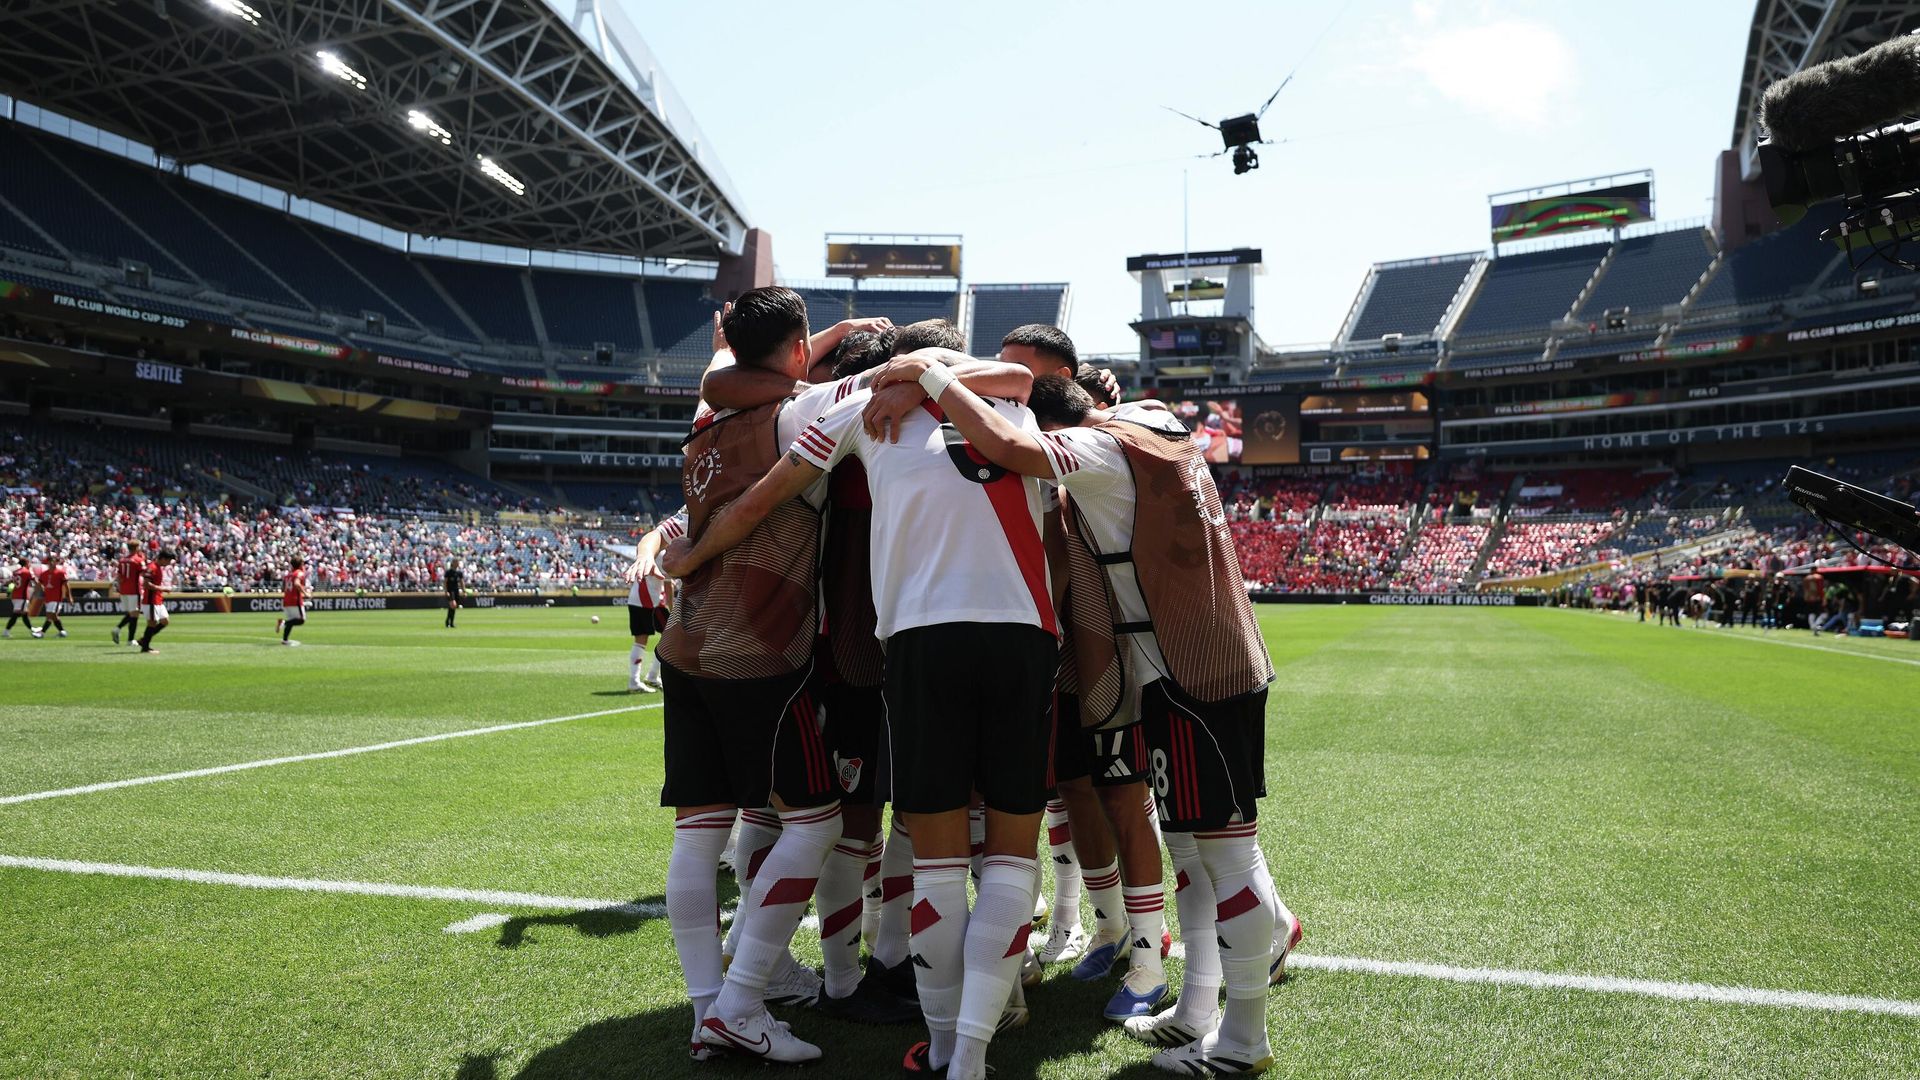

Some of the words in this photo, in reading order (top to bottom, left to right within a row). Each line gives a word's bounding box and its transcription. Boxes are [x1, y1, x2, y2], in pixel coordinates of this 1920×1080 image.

[1162, 260, 1178, 268] CLUB
[1220, 256, 1237, 264] 2025
[54, 294, 75, 307] FIFA
[78, 300, 102, 311] CLUB
[105, 304, 139, 319] WORLD
[142, 312, 160, 322] CUP
[1788, 330, 1808, 342] FIFA
[1810, 327, 1834, 338] CLUB
[1836, 321, 1872, 334] WORLD
[1874, 318, 1895, 329] CUP
[232, 328, 250, 340] FIFA
[251, 332, 272, 344] CLUB
[273, 336, 302, 348] WORLD
[304, 342, 320, 352] CUP
[1178, 335, 1197, 343] FIFA
[1620, 354, 1638, 362] FIFA
[1696, 343, 1714, 352] CUP
[378, 355, 394, 366] FIFA
[394, 358, 412, 368] CLUB
[413, 361, 438, 373] WORLD
[439, 366, 452, 374] CUP
[1465, 370, 1482, 378] FIFA
[1483, 368, 1503, 376] CLUB
[1505, 364, 1534, 374] WORLD
[1536, 362, 1552, 372] CUP
[136, 362, 182, 384] SEATTLE
[502, 376, 516, 386] FIFA
[518, 378, 536, 388] CLUB
[568, 382, 584, 392] CUP
[644, 387, 660, 395] FIFA
[662, 388, 681, 396] CLUB
[682, 388, 700, 397] WOR
[1184, 388, 1198, 396] FIFA
[1200, 387, 1219, 395] CLUB
[1220, 386, 1246, 394] WORLD
[1689, 388, 1708, 398] FIFA
[1496, 406, 1512, 414] FIFA
[1514, 404, 1534, 413] CLUB
[1585, 432, 1649, 449] HOME
[1669, 430, 1696, 443] OF
[1715, 424, 1760, 440] THE
[581, 454, 683, 468] WELCOME
[121, 562, 130, 578] 11
[180, 600, 204, 611] 2025
[314, 599, 332, 610] THE
[336, 598, 357, 610] FIFA
[358, 598, 386, 609] STORE
[476, 598, 495, 607] VISIT
[1370, 594, 1406, 605] CHECK
[1407, 594, 1430, 605] OUT
[1432, 595, 1453, 605] THE
[1456, 595, 1480, 606] FIFA
[1480, 595, 1515, 606] STORE
[84, 602, 112, 612] CLUB
